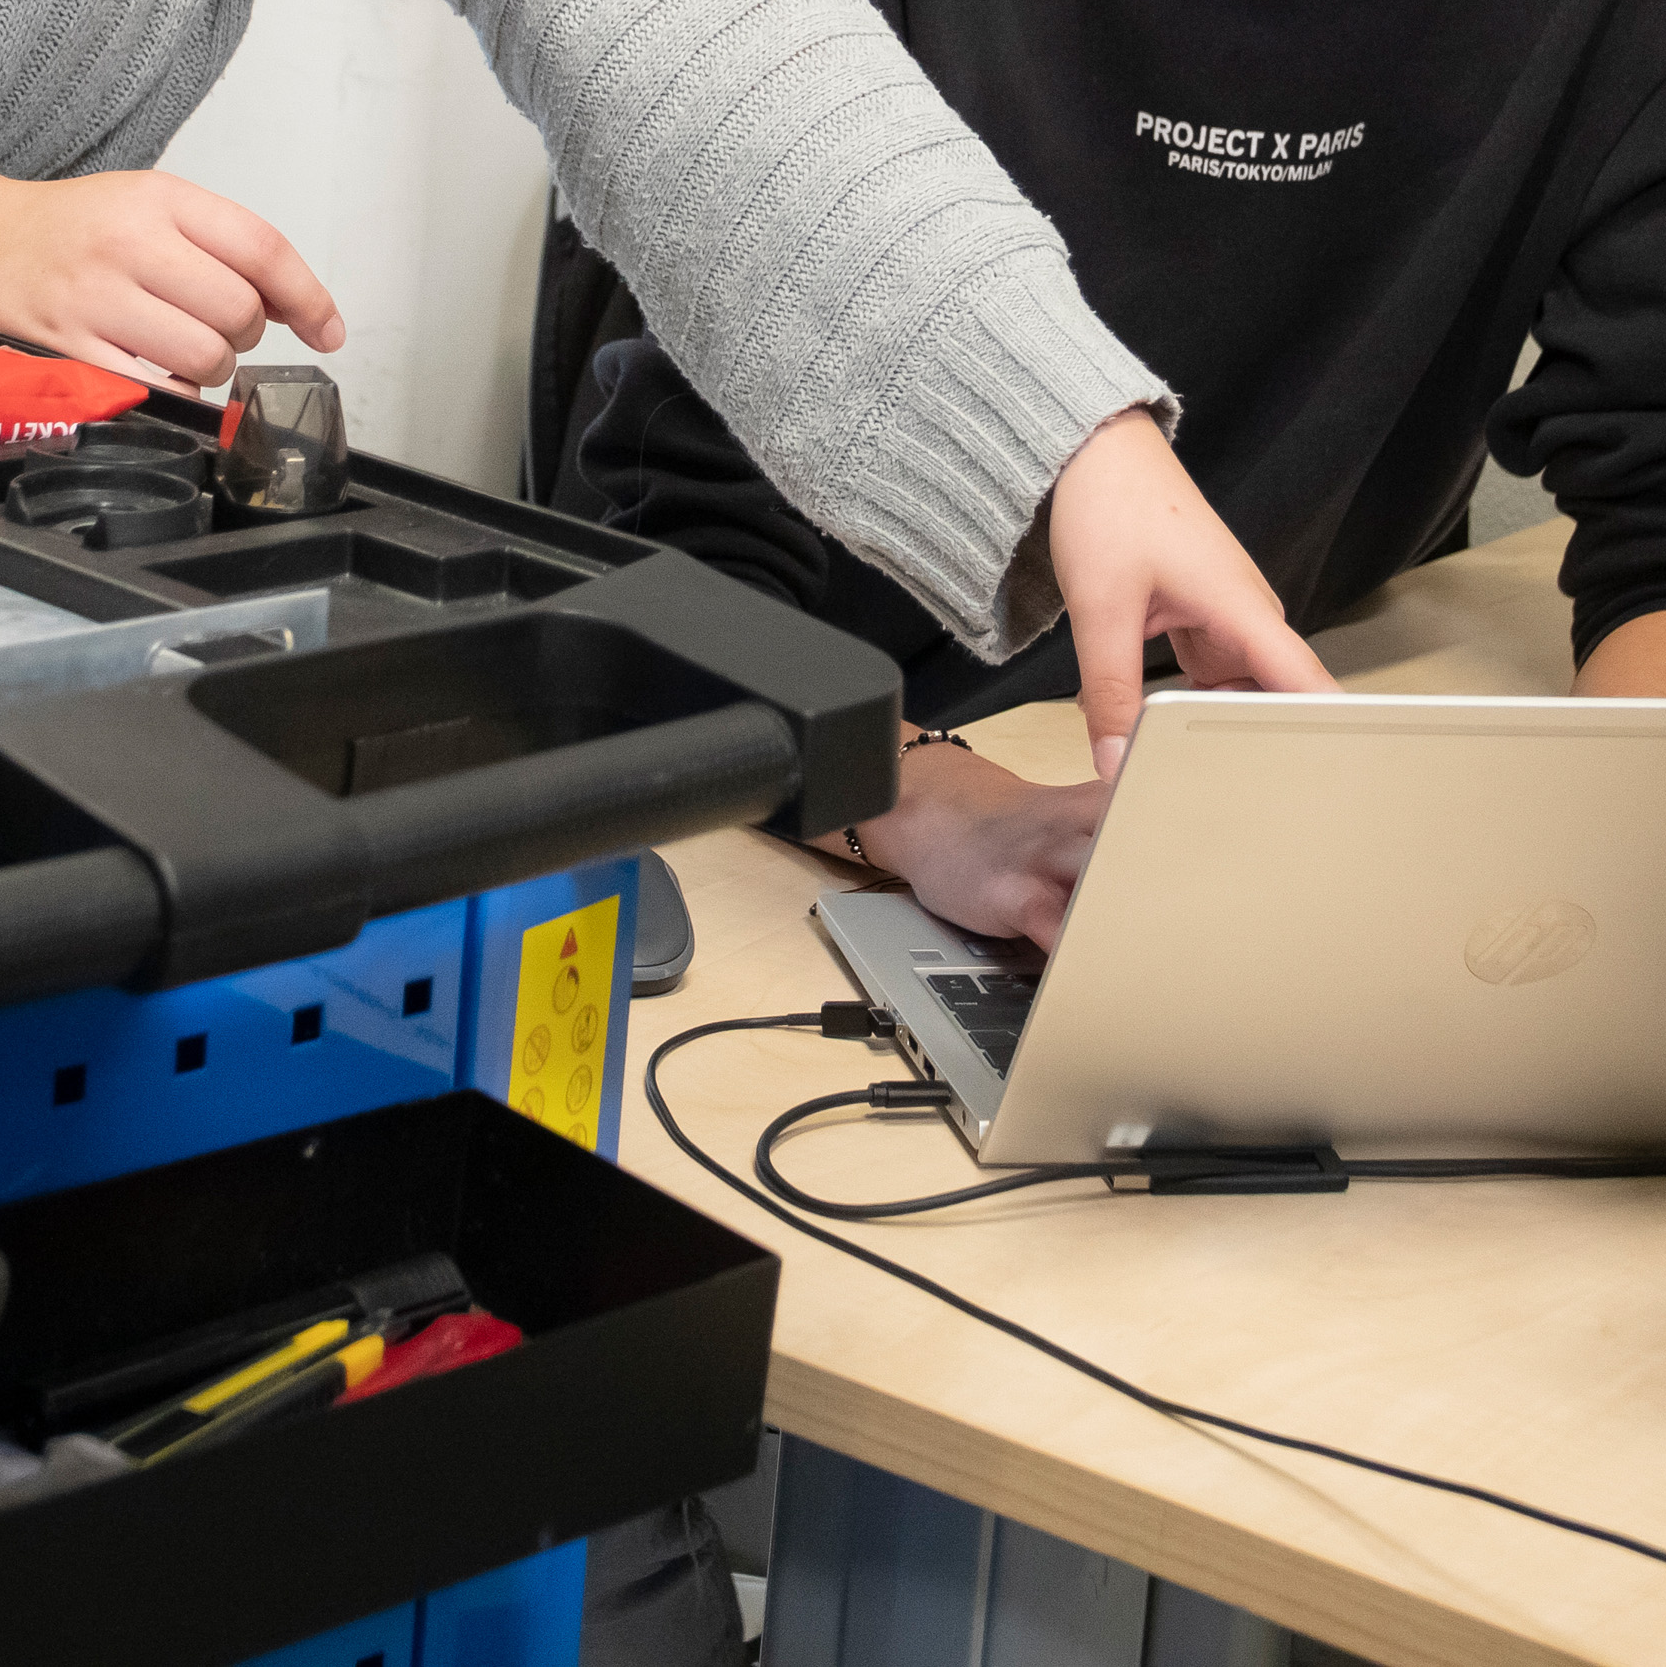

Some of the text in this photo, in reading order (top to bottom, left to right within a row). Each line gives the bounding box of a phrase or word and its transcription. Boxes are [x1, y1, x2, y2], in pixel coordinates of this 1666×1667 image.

[1135, 110, 1366, 160] PROJECT X PARIS
[1167, 150, 1333, 182] PARIS/TOKYO/MILAN
